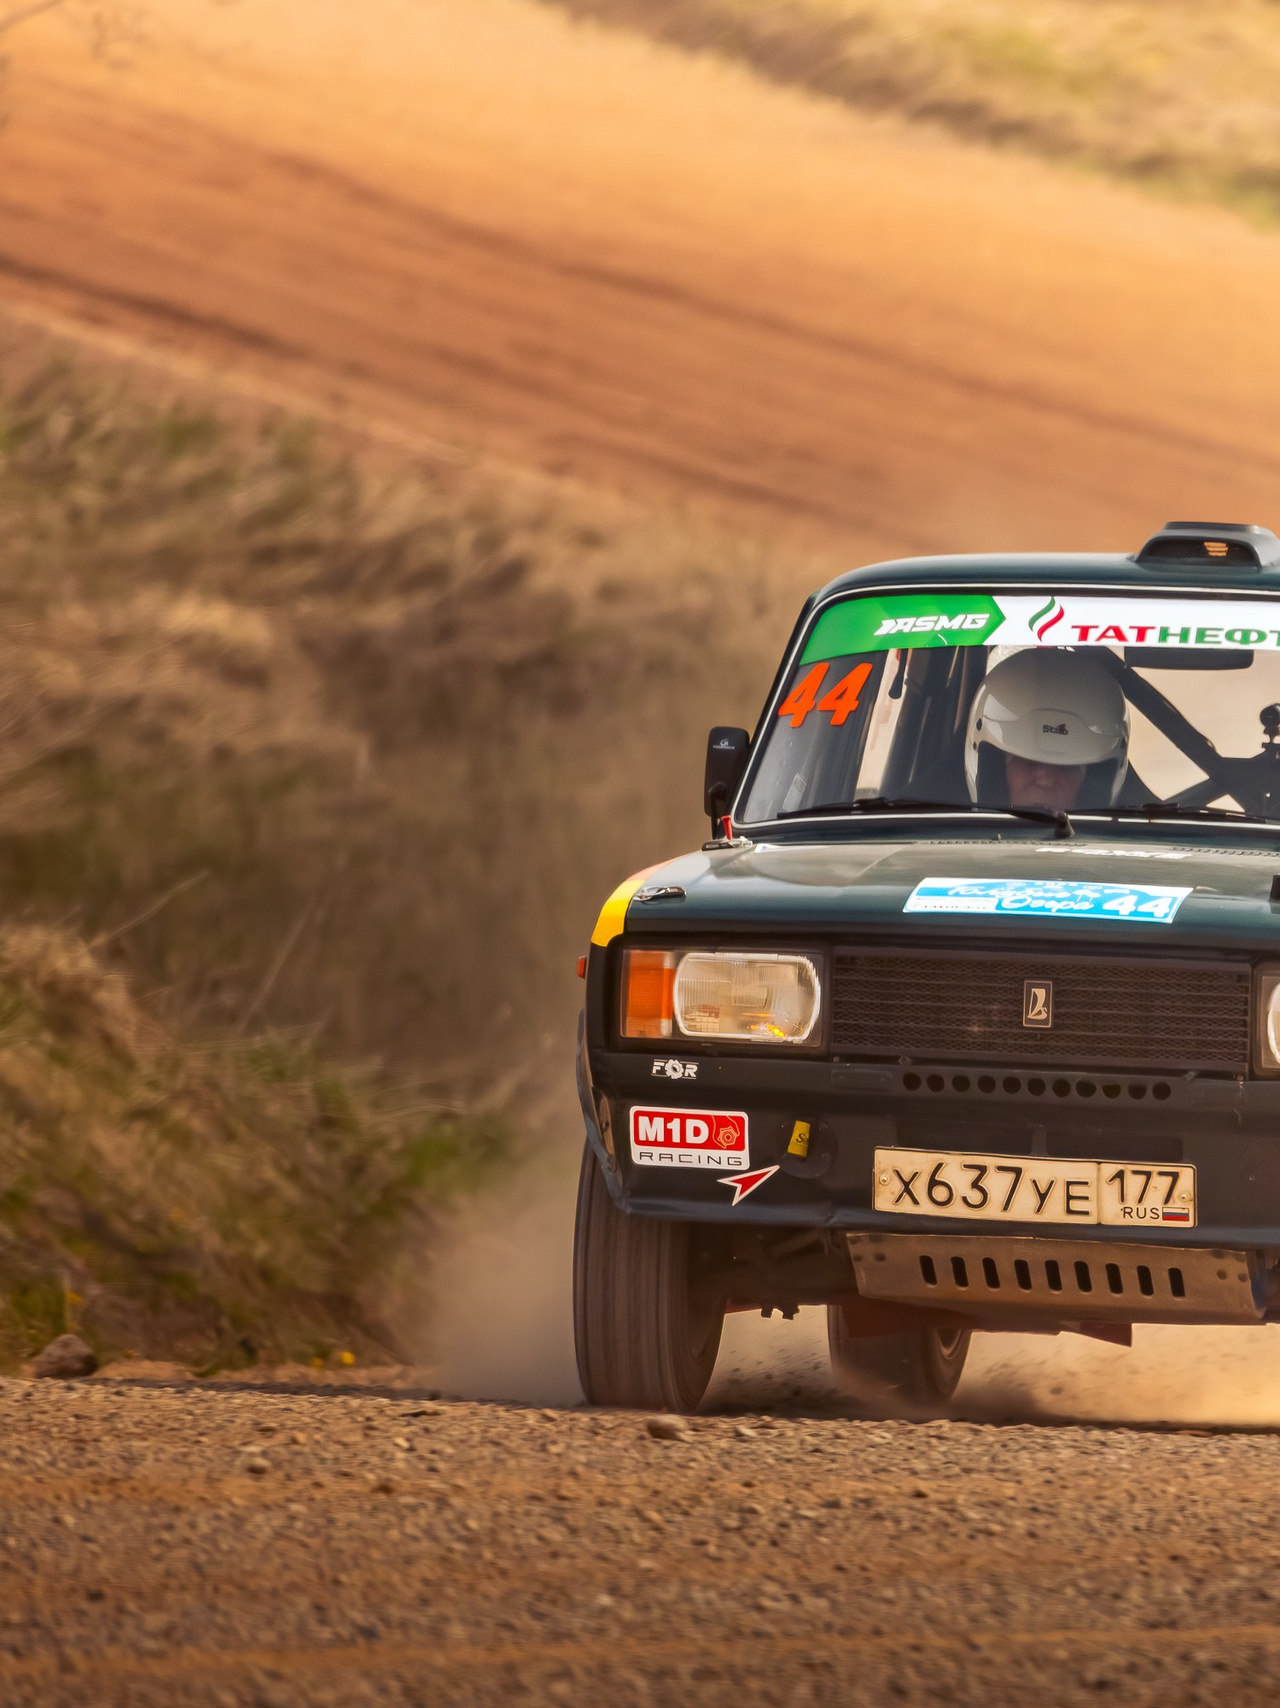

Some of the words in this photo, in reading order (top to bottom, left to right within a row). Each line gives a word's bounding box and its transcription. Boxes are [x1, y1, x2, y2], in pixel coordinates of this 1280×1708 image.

[778, 662, 873, 728] 44
[1102, 894, 1173, 918] 44
[638, 1115, 710, 1144] M1D
[639, 1151, 742, 1167] RACING
[1106, 1169, 1180, 1205] 177
[1122, 1206, 1160, 1221] RUS
